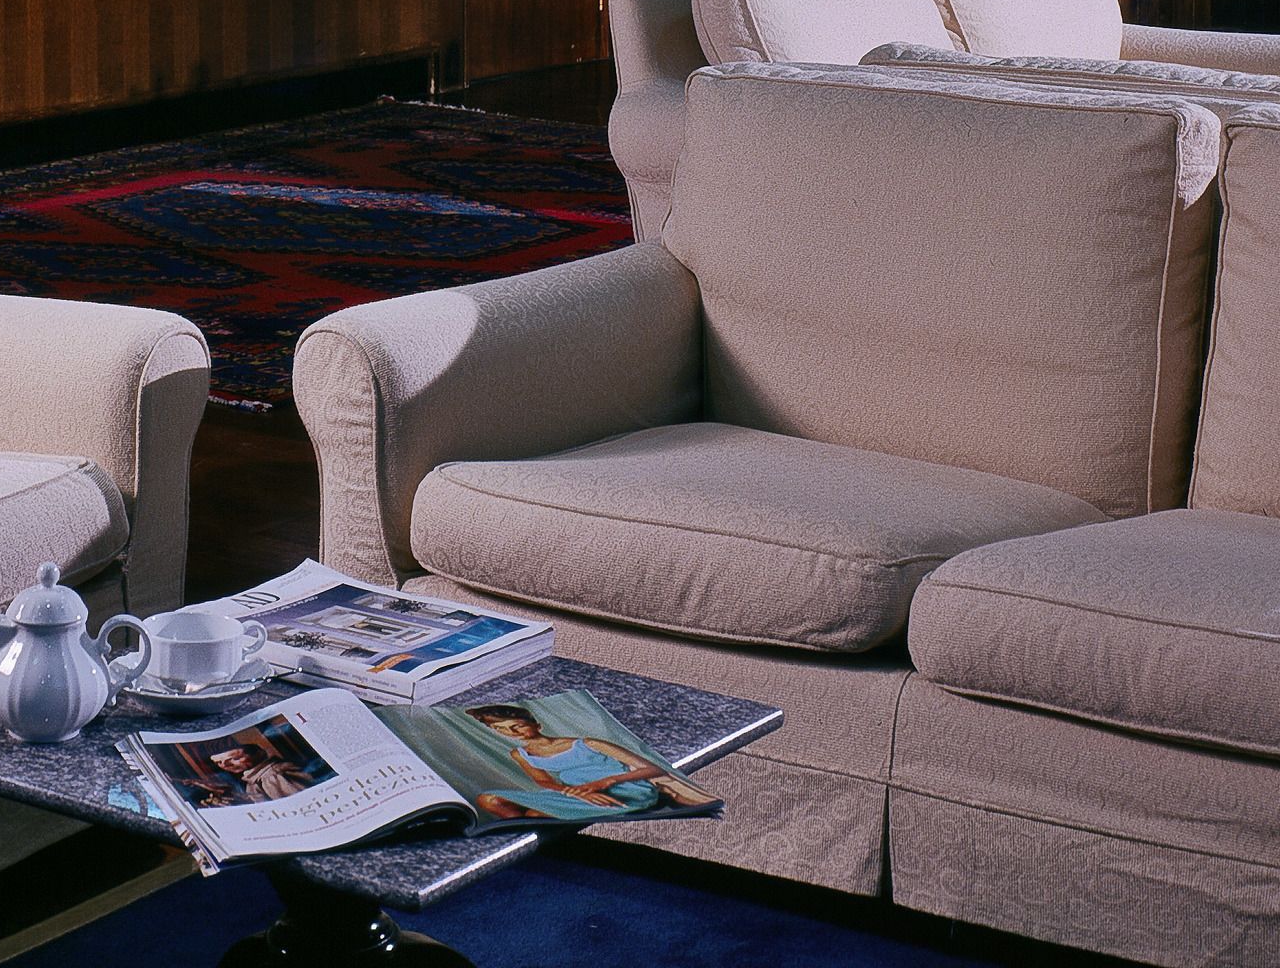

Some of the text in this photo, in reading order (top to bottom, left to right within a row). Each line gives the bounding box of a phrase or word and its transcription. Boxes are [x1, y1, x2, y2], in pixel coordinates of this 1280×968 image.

[231, 591, 281, 610] AD
[247, 794, 339, 823] Elogio
[349, 765, 412, 793] della
